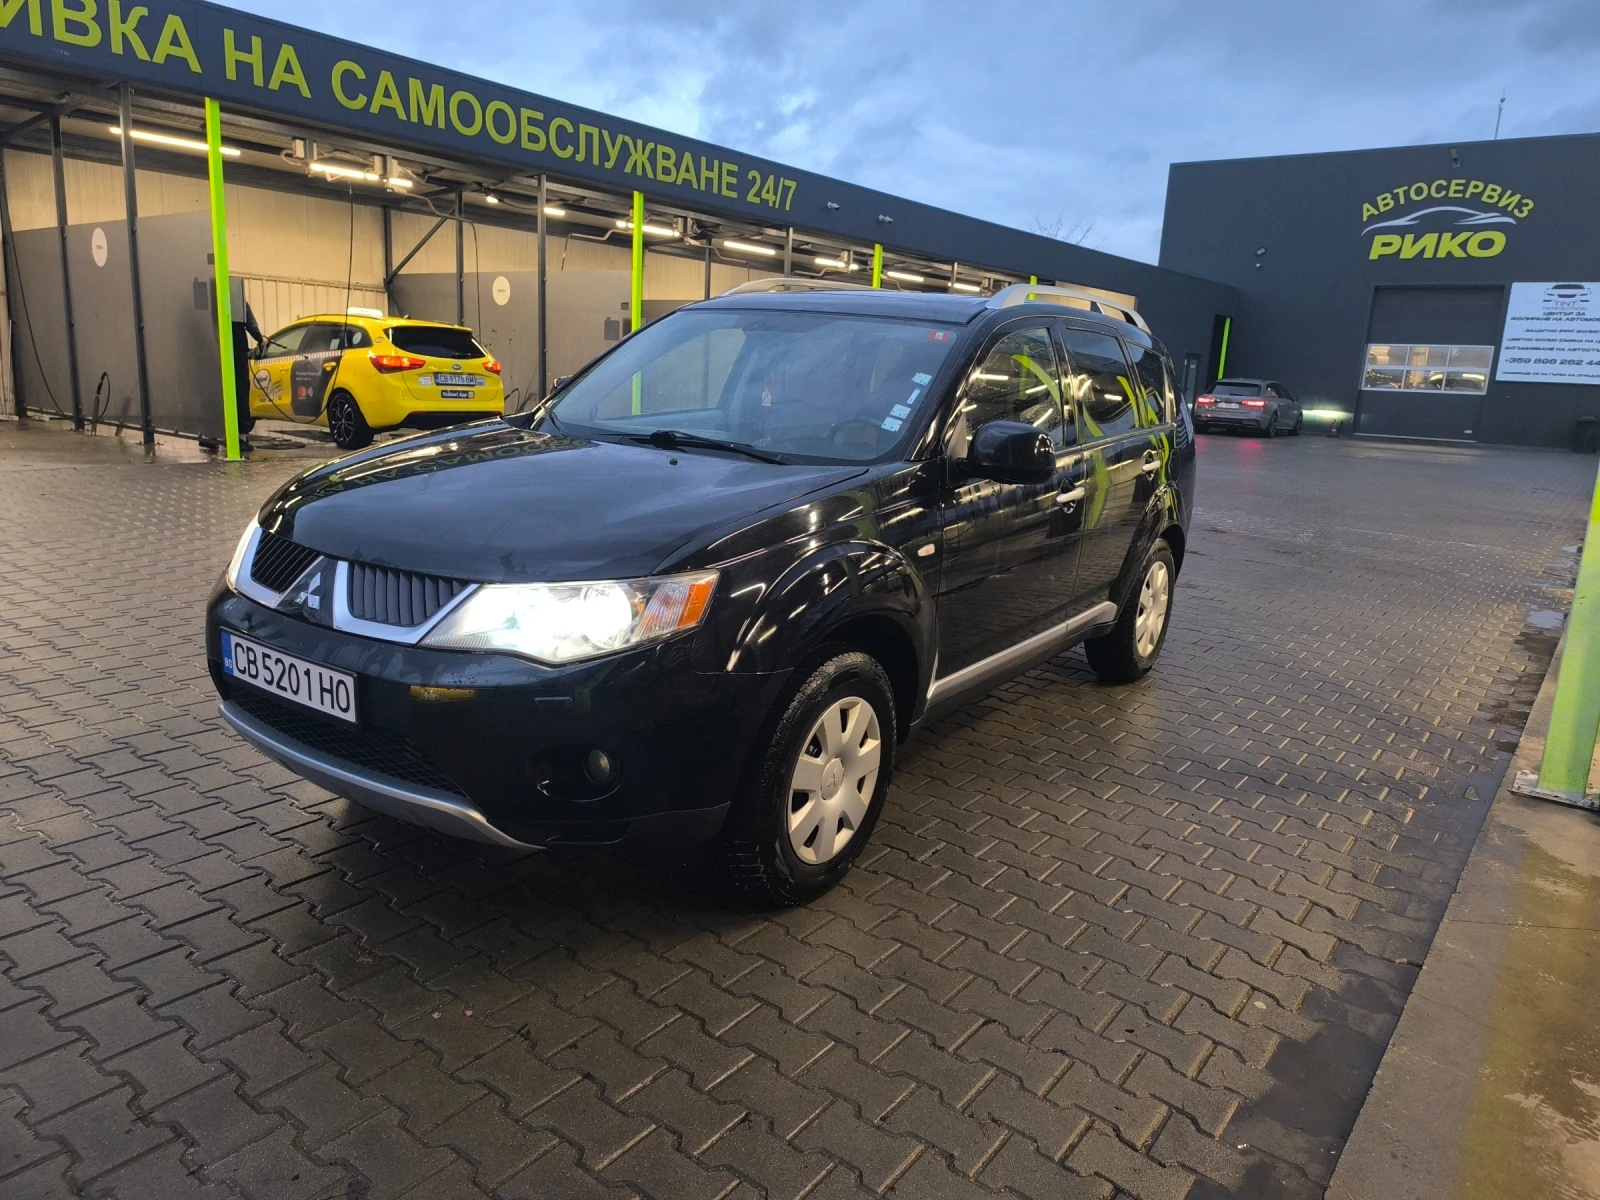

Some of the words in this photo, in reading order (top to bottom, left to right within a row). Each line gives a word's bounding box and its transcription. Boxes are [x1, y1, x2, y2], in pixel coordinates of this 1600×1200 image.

[223, 28, 312, 99] НА
[331, 60, 739, 199] САМООБСЛУЖВАНЕ
[746, 169, 798, 211] 24/7
[1361, 179, 1535, 222] АВТОСЕРВИЗ
[1368, 230, 1507, 260] РИКО
[224, 656, 233, 669] BG
[234, 641, 259, 680] CB
[261, 651, 312, 702] 5201
[318, 671, 350, 713] HO
